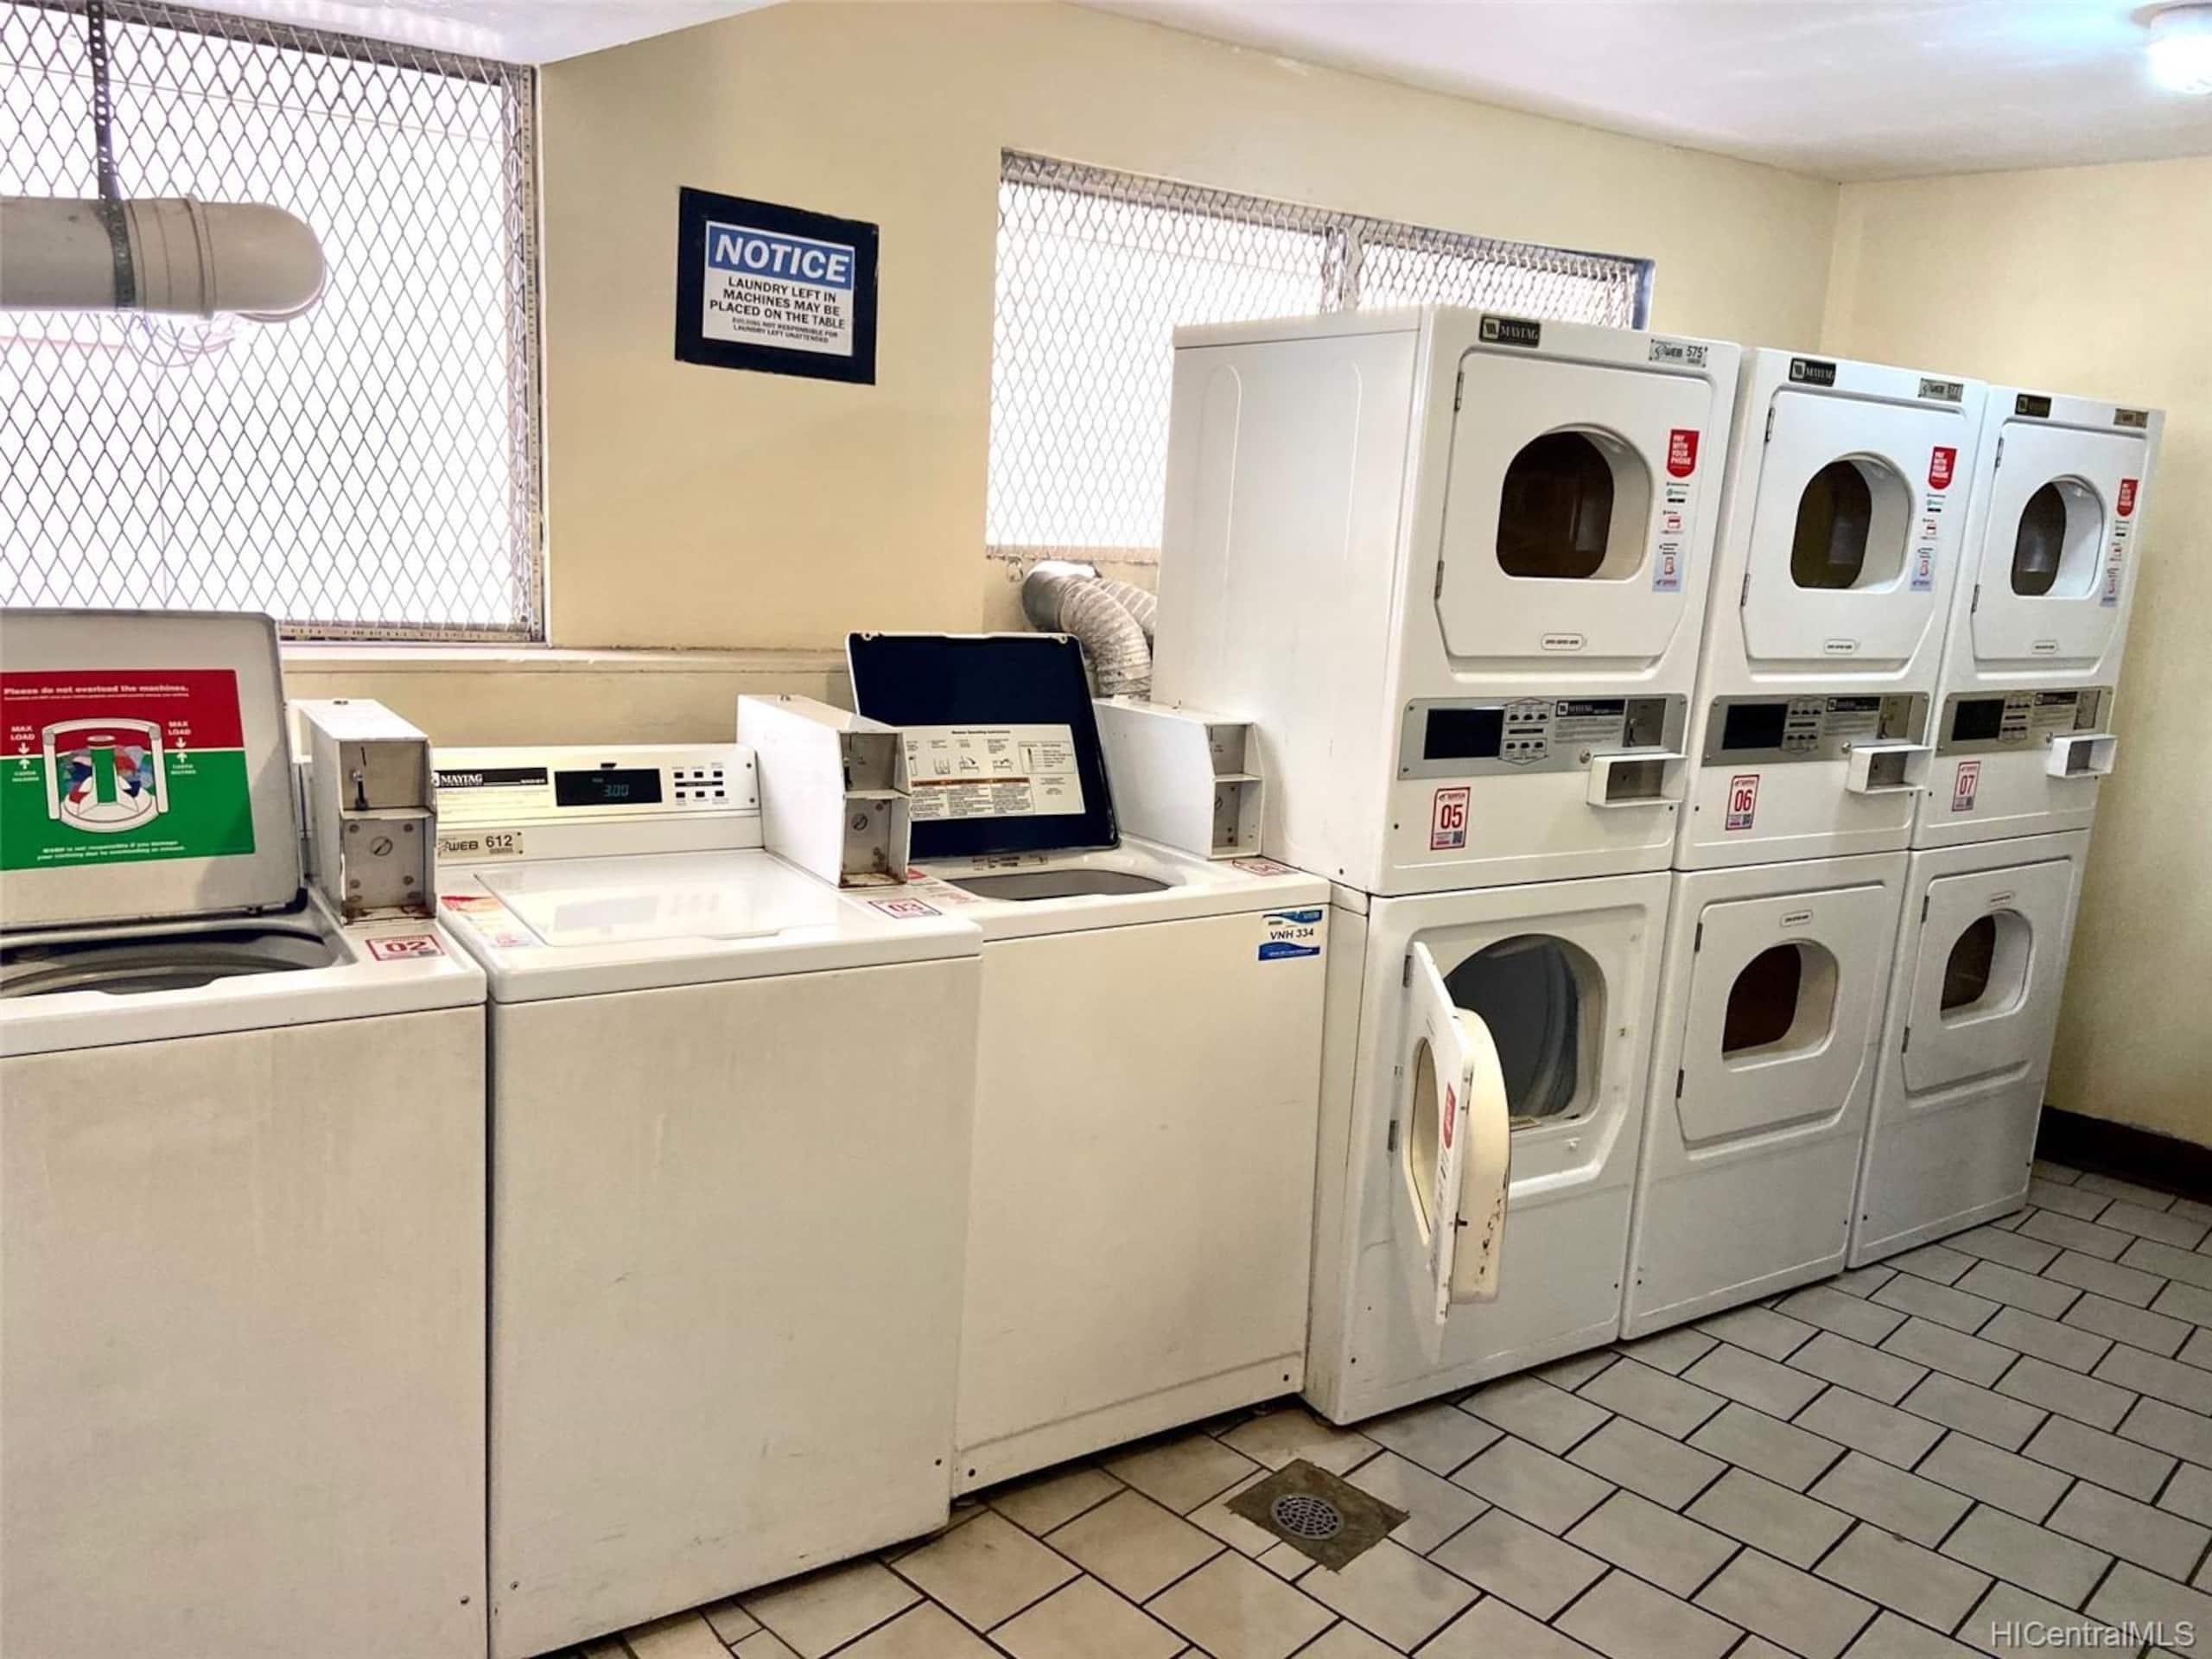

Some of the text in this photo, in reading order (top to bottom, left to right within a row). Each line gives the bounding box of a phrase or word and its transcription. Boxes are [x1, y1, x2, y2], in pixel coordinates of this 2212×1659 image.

[715, 234, 849, 283] NOTICE
[728, 276, 836, 302] LAUNDRY LEFT IN
[723, 289, 841, 316] MACHINES MAY BE
[709, 300, 845, 329] PLACED ON THE TABLE
[734, 325, 829, 343] LAUNDRY LEFT UNATTENDED
[778, 325, 823, 336] RESPONSIBLE
[1687, 345, 1702, 359] 575
[3, 688, 39, 696] Please
[75, 685, 118, 694] overload
[436, 773, 483, 786] MAYTAG
[1960, 774, 1974, 795] 07
[1735, 789, 1752, 811] 06
[1440, 804, 1463, 830] 05
[448, 841, 479, 851] WEB
[486, 835, 512, 848] 612
[1270, 928, 1313, 940] VNH 334
[385, 941, 427, 951] 02
